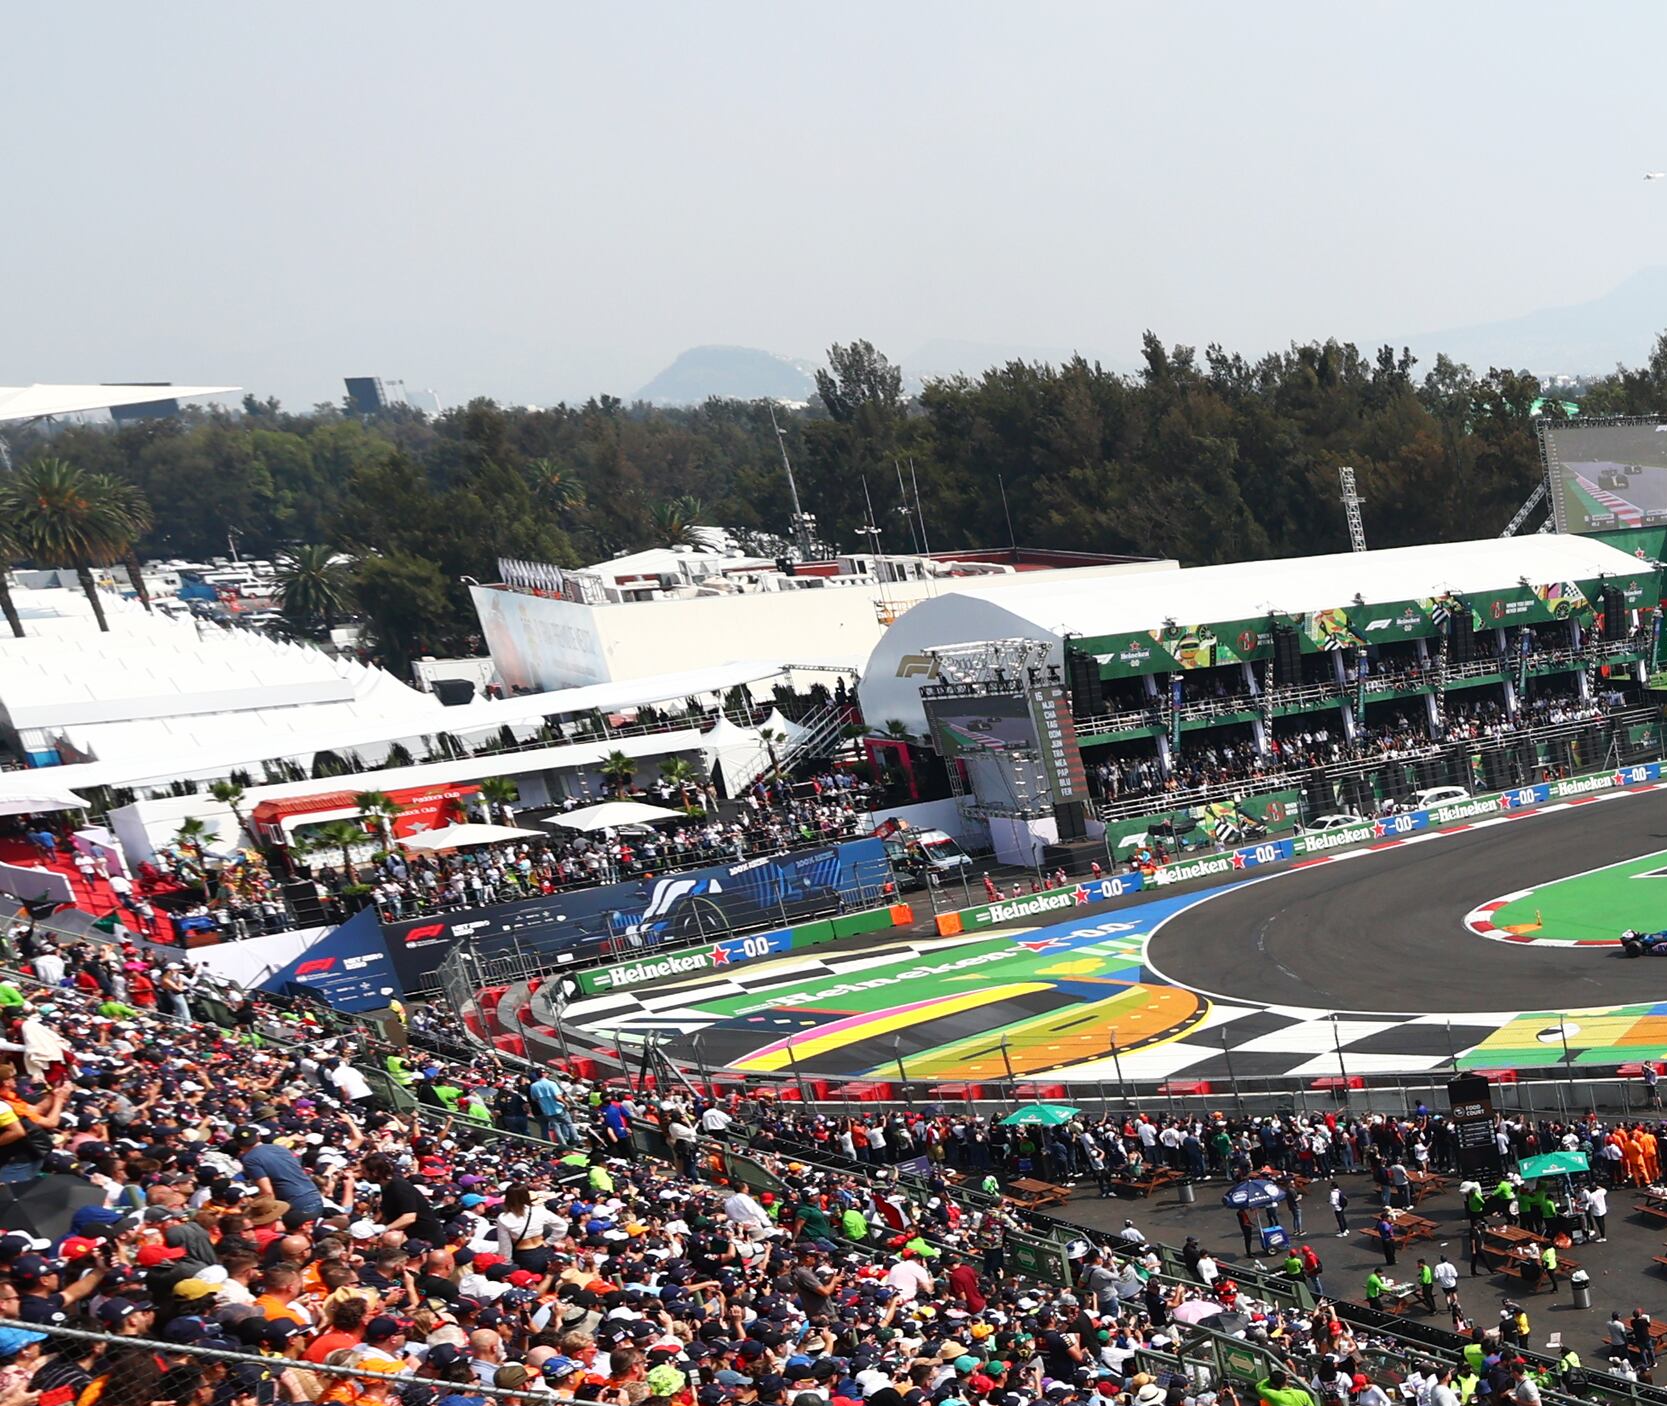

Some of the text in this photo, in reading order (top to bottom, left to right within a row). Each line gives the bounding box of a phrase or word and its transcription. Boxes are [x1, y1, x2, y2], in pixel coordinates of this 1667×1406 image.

[1557, 773, 1612, 796] Heineken
[1439, 800, 1497, 823] Heineken
[1305, 826, 1370, 851] Heineken
[989, 892, 1071, 923] Heineken
[608, 956, 708, 988] Heineken
[1466, 1109, 1485, 1117] COURT
